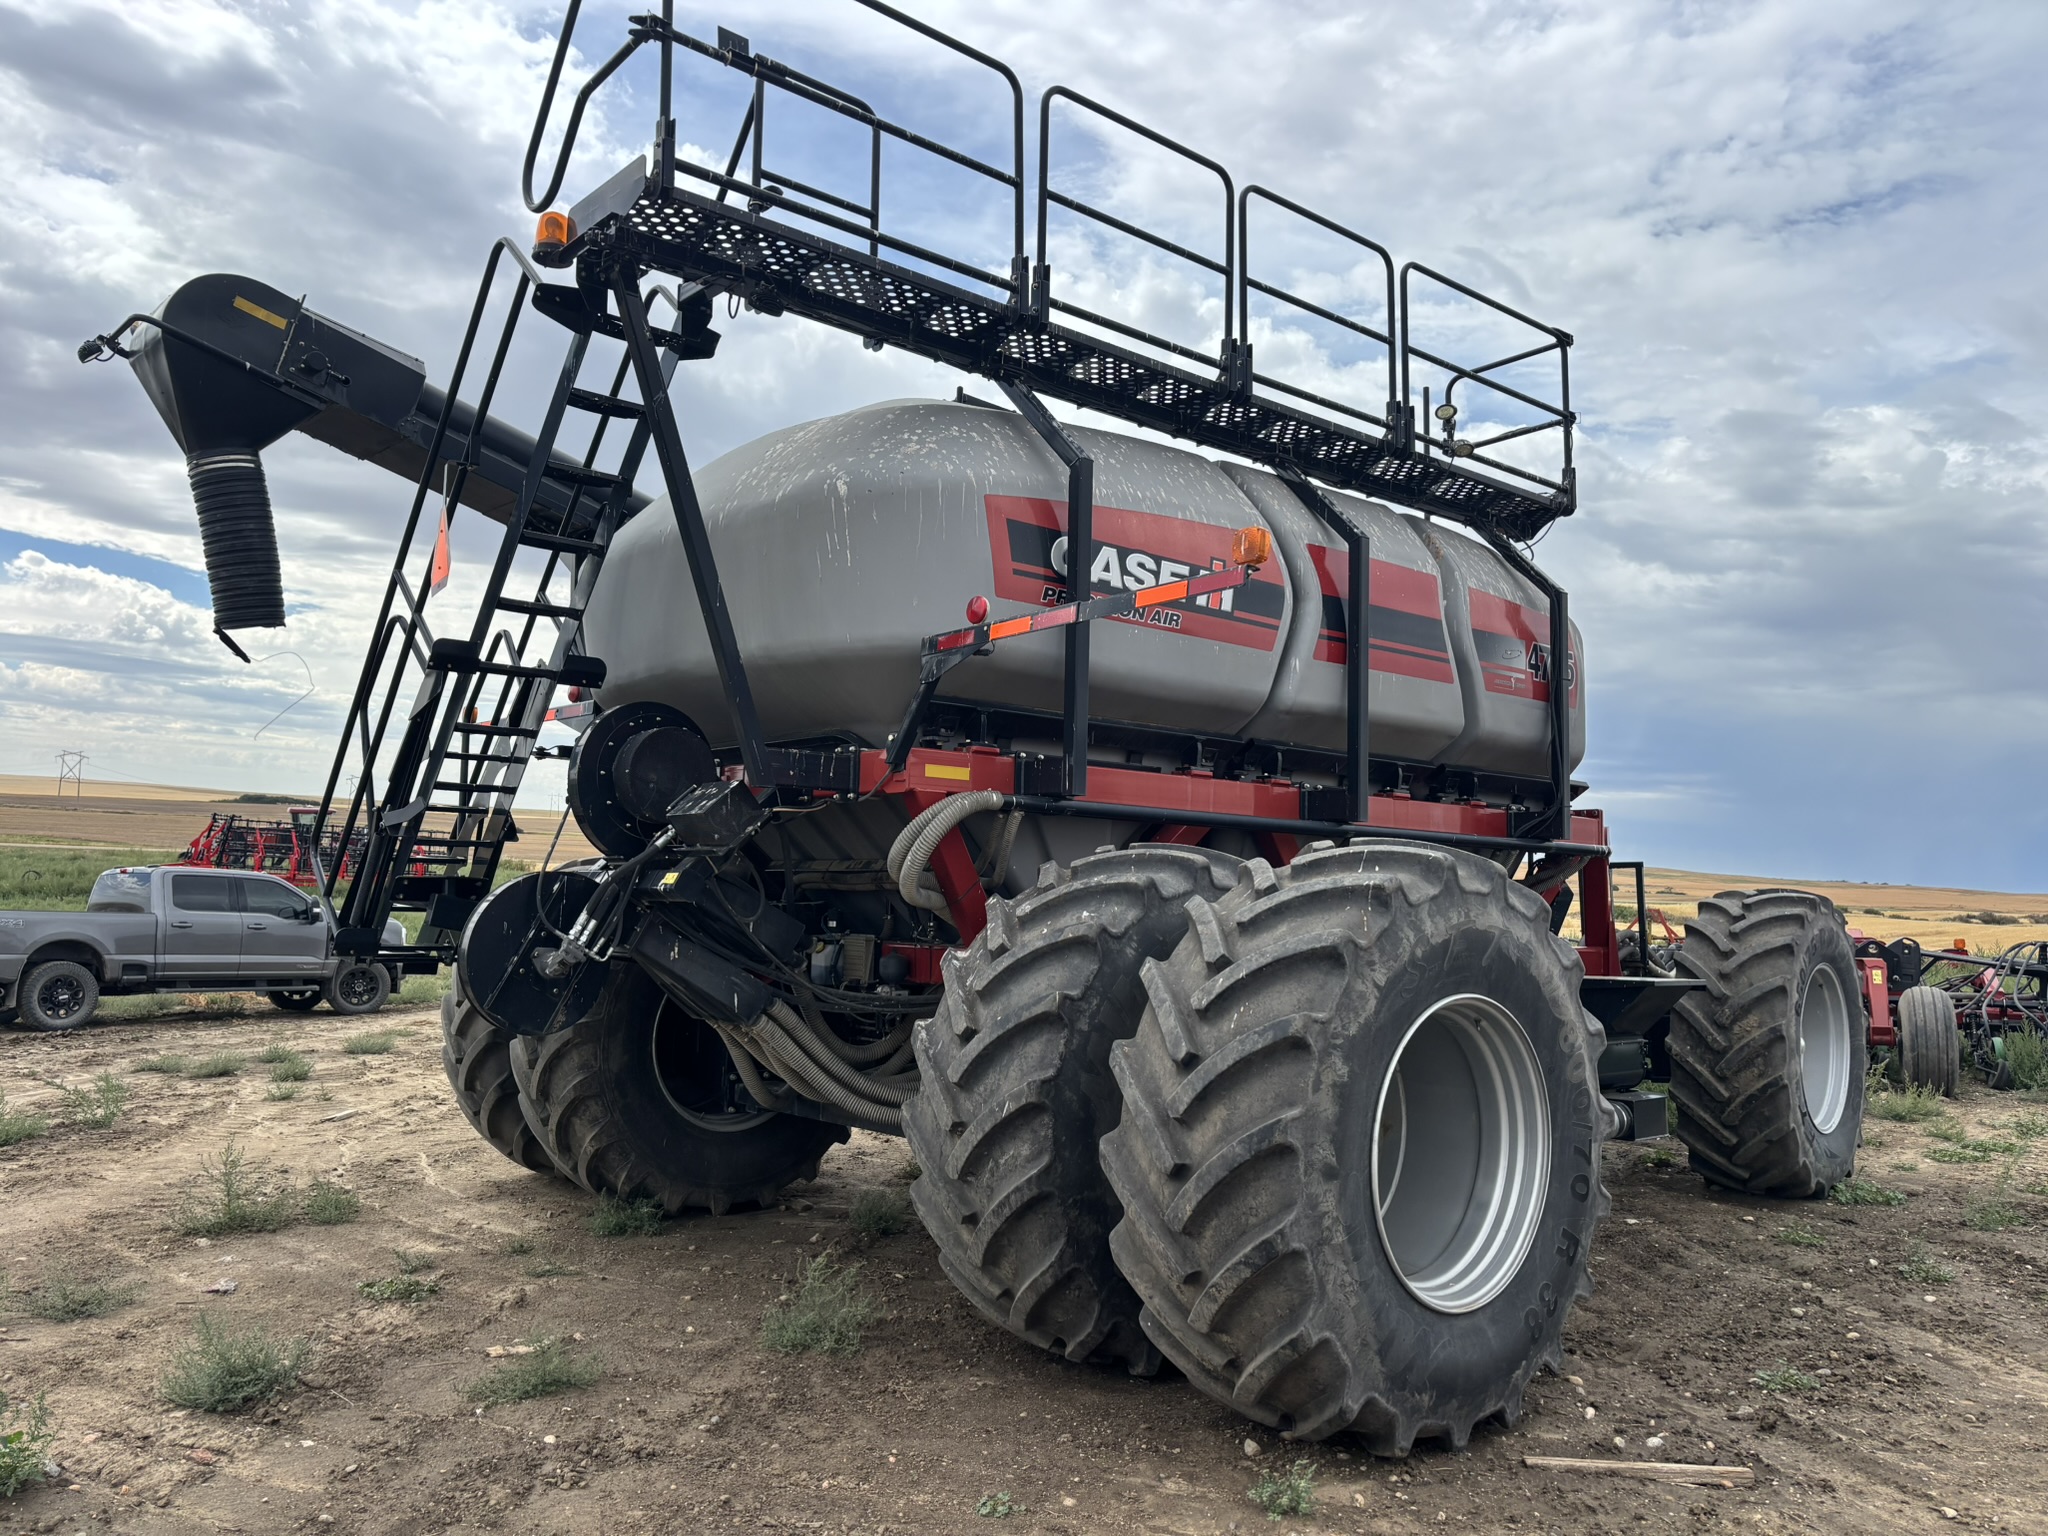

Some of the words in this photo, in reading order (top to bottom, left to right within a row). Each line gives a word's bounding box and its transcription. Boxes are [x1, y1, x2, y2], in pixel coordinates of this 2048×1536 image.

[1148, 608, 1182, 630] AIR
[1526, 641, 1576, 690] 475
[1558, 1020, 1593, 1203] 800/70
[1555, 1226, 1580, 1267] R
[1523, 1281, 1558, 1344] 38
